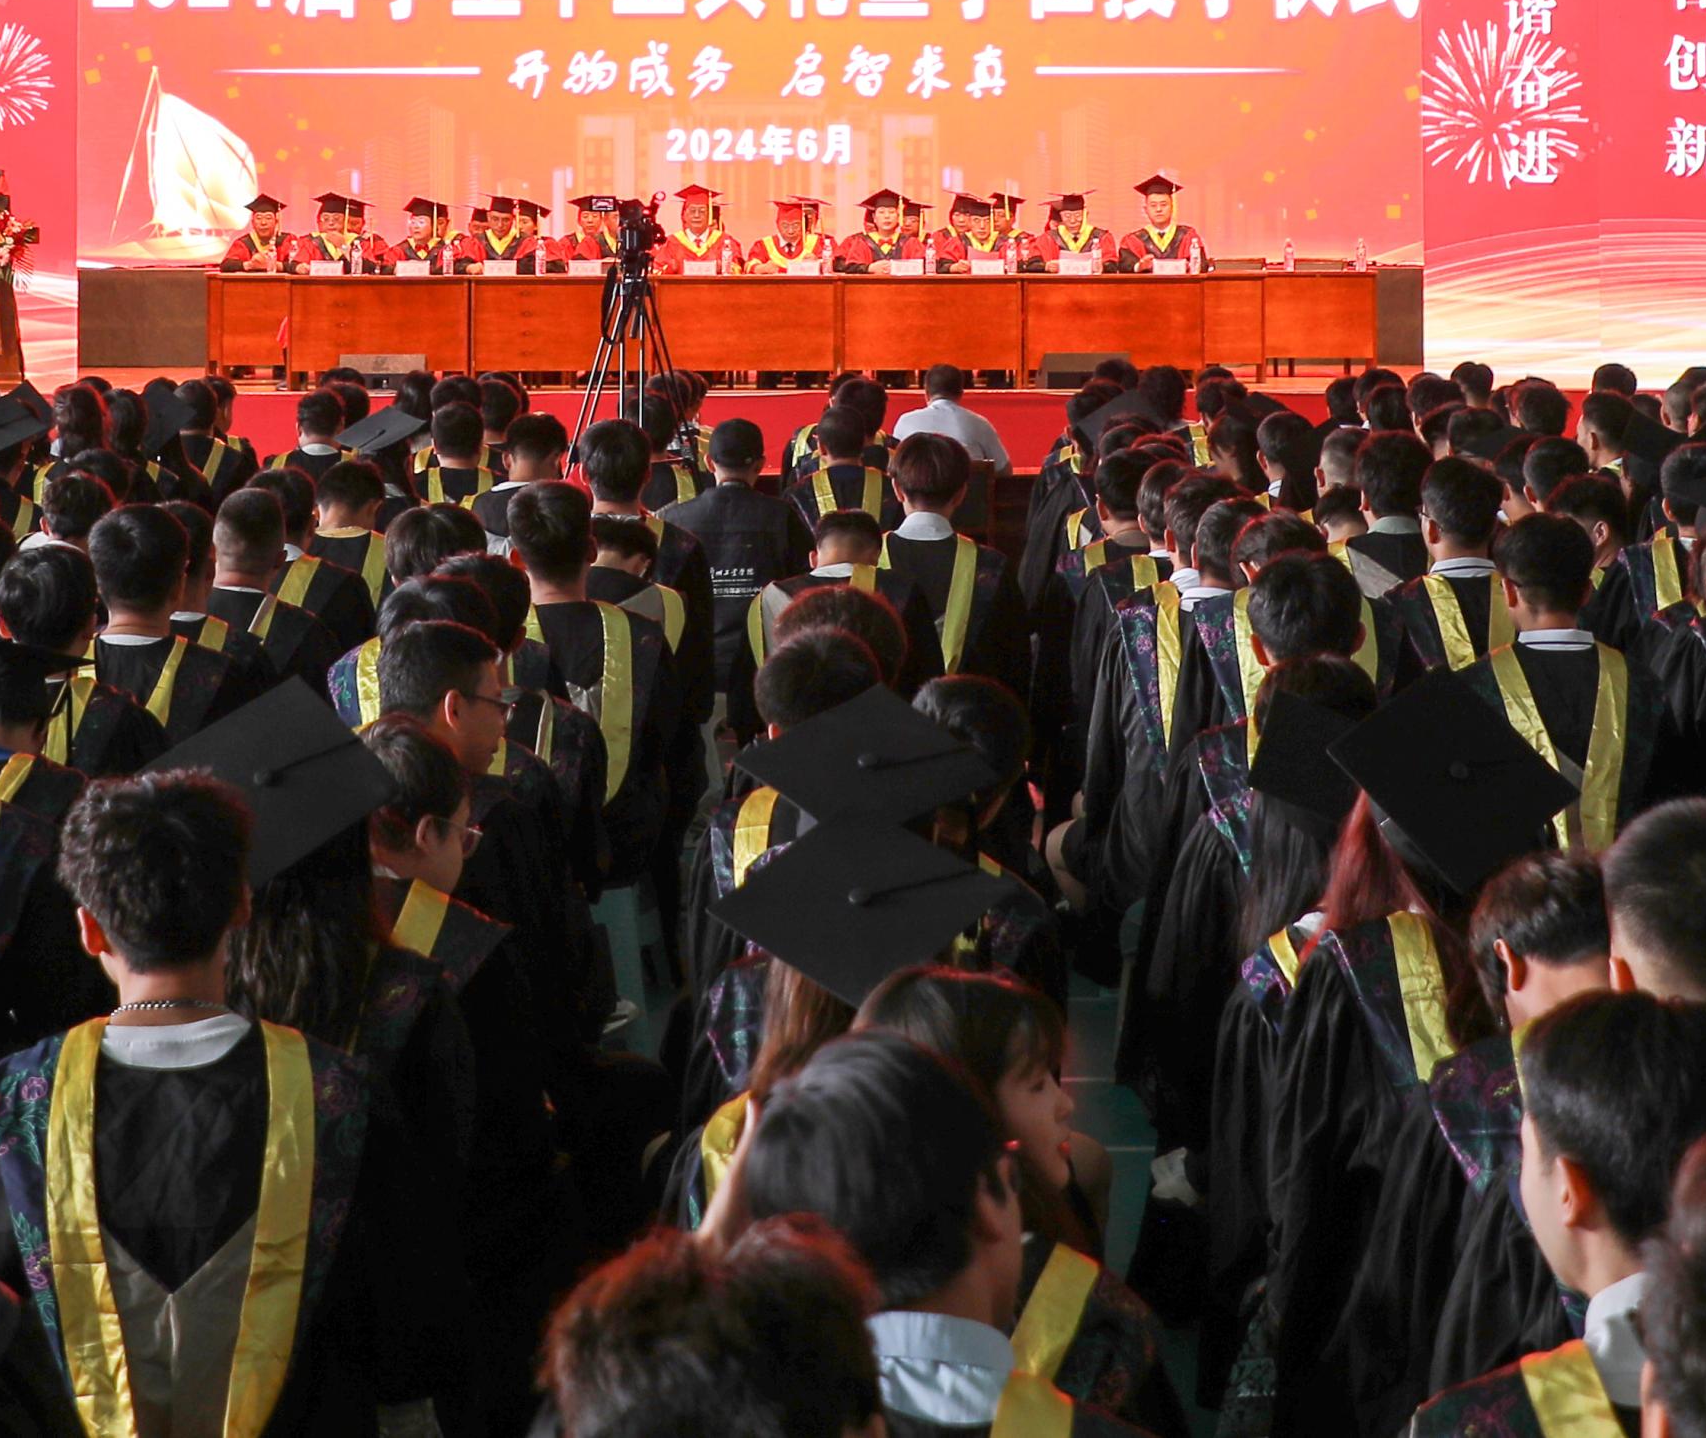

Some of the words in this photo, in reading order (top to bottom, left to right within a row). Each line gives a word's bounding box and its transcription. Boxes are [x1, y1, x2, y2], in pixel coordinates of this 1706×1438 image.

[507, 40, 734, 99] 开物成务
[780, 43, 1008, 99] 启智求真
[665, 123, 852, 164] 2024年6月
